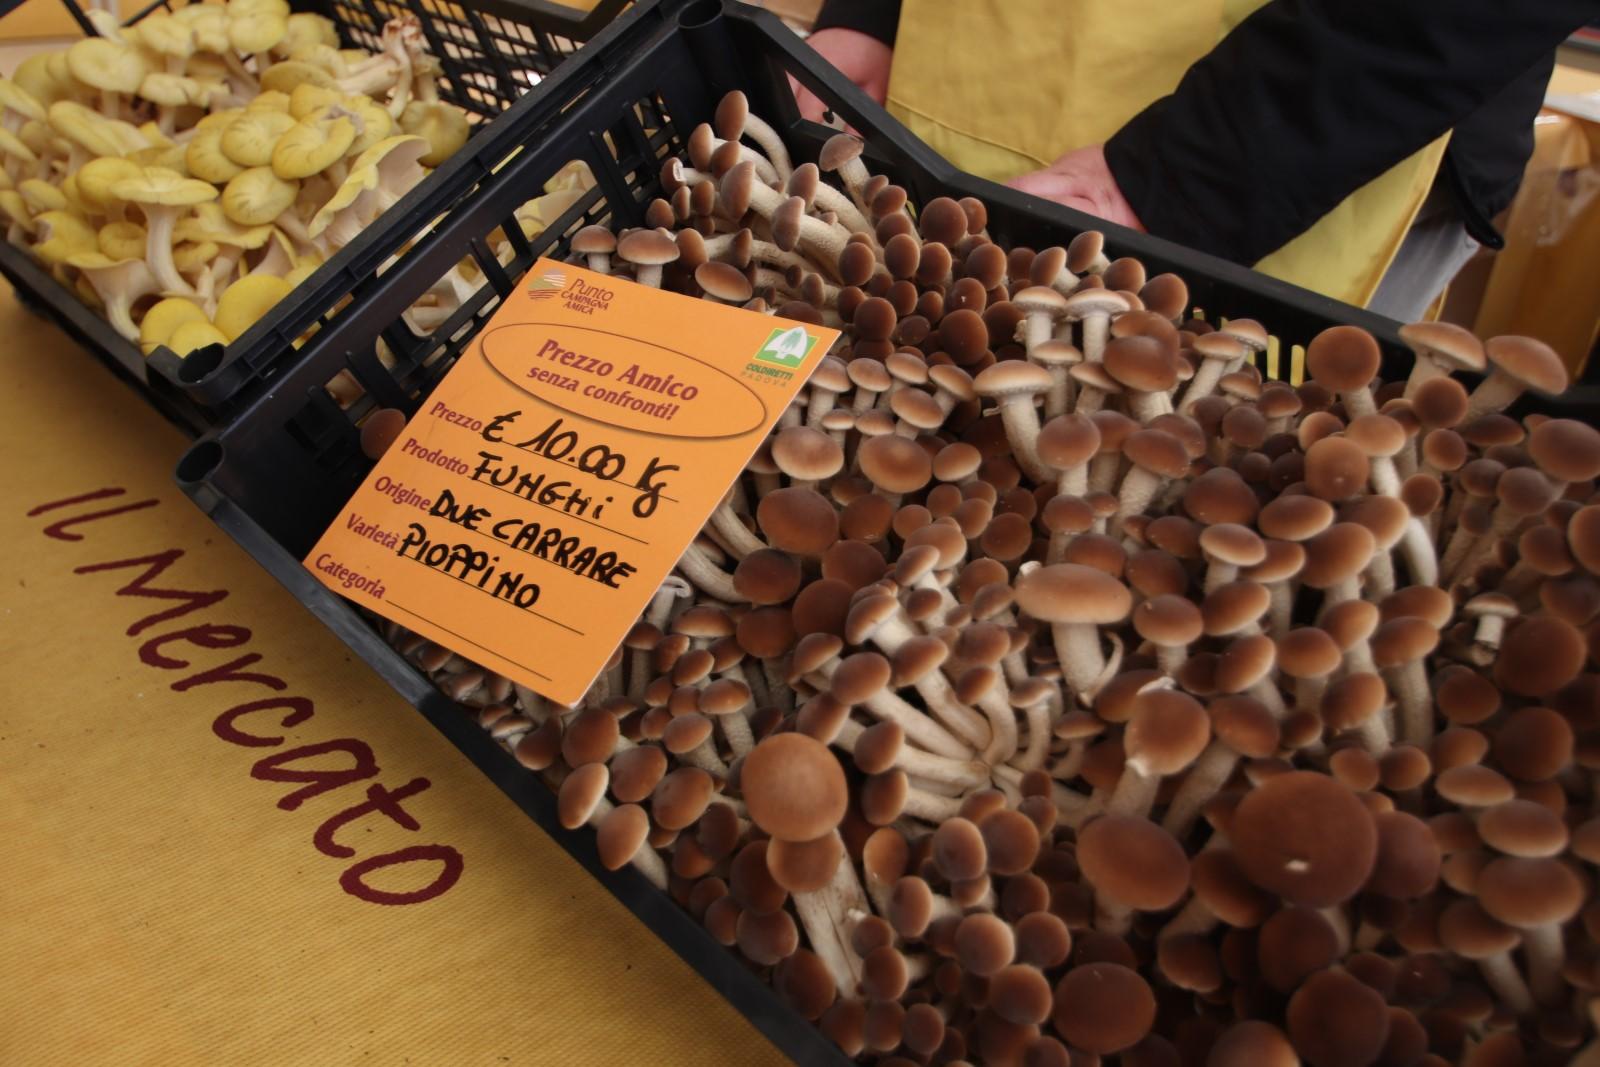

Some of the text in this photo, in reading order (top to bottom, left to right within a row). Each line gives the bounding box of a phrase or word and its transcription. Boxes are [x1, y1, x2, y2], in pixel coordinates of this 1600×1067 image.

[560, 290, 609, 311] CAMPAGNA
[563, 301, 594, 315] AMICA
[568, 278, 614, 302] Punto
[526, 366, 680, 421] senza confronti!
[536, 339, 698, 401] Prezzo Amico
[401, 438, 469, 476] Prodotto
[430, 401, 483, 432] Prezzo
[515, 418, 626, 481] 10.00
[346, 513, 400, 550] Varietà
[375, 476, 637, 589] Origine DUE CARRARE
[315, 553, 386, 600] Categoria
[73, 548, 464, 906] Mercato
